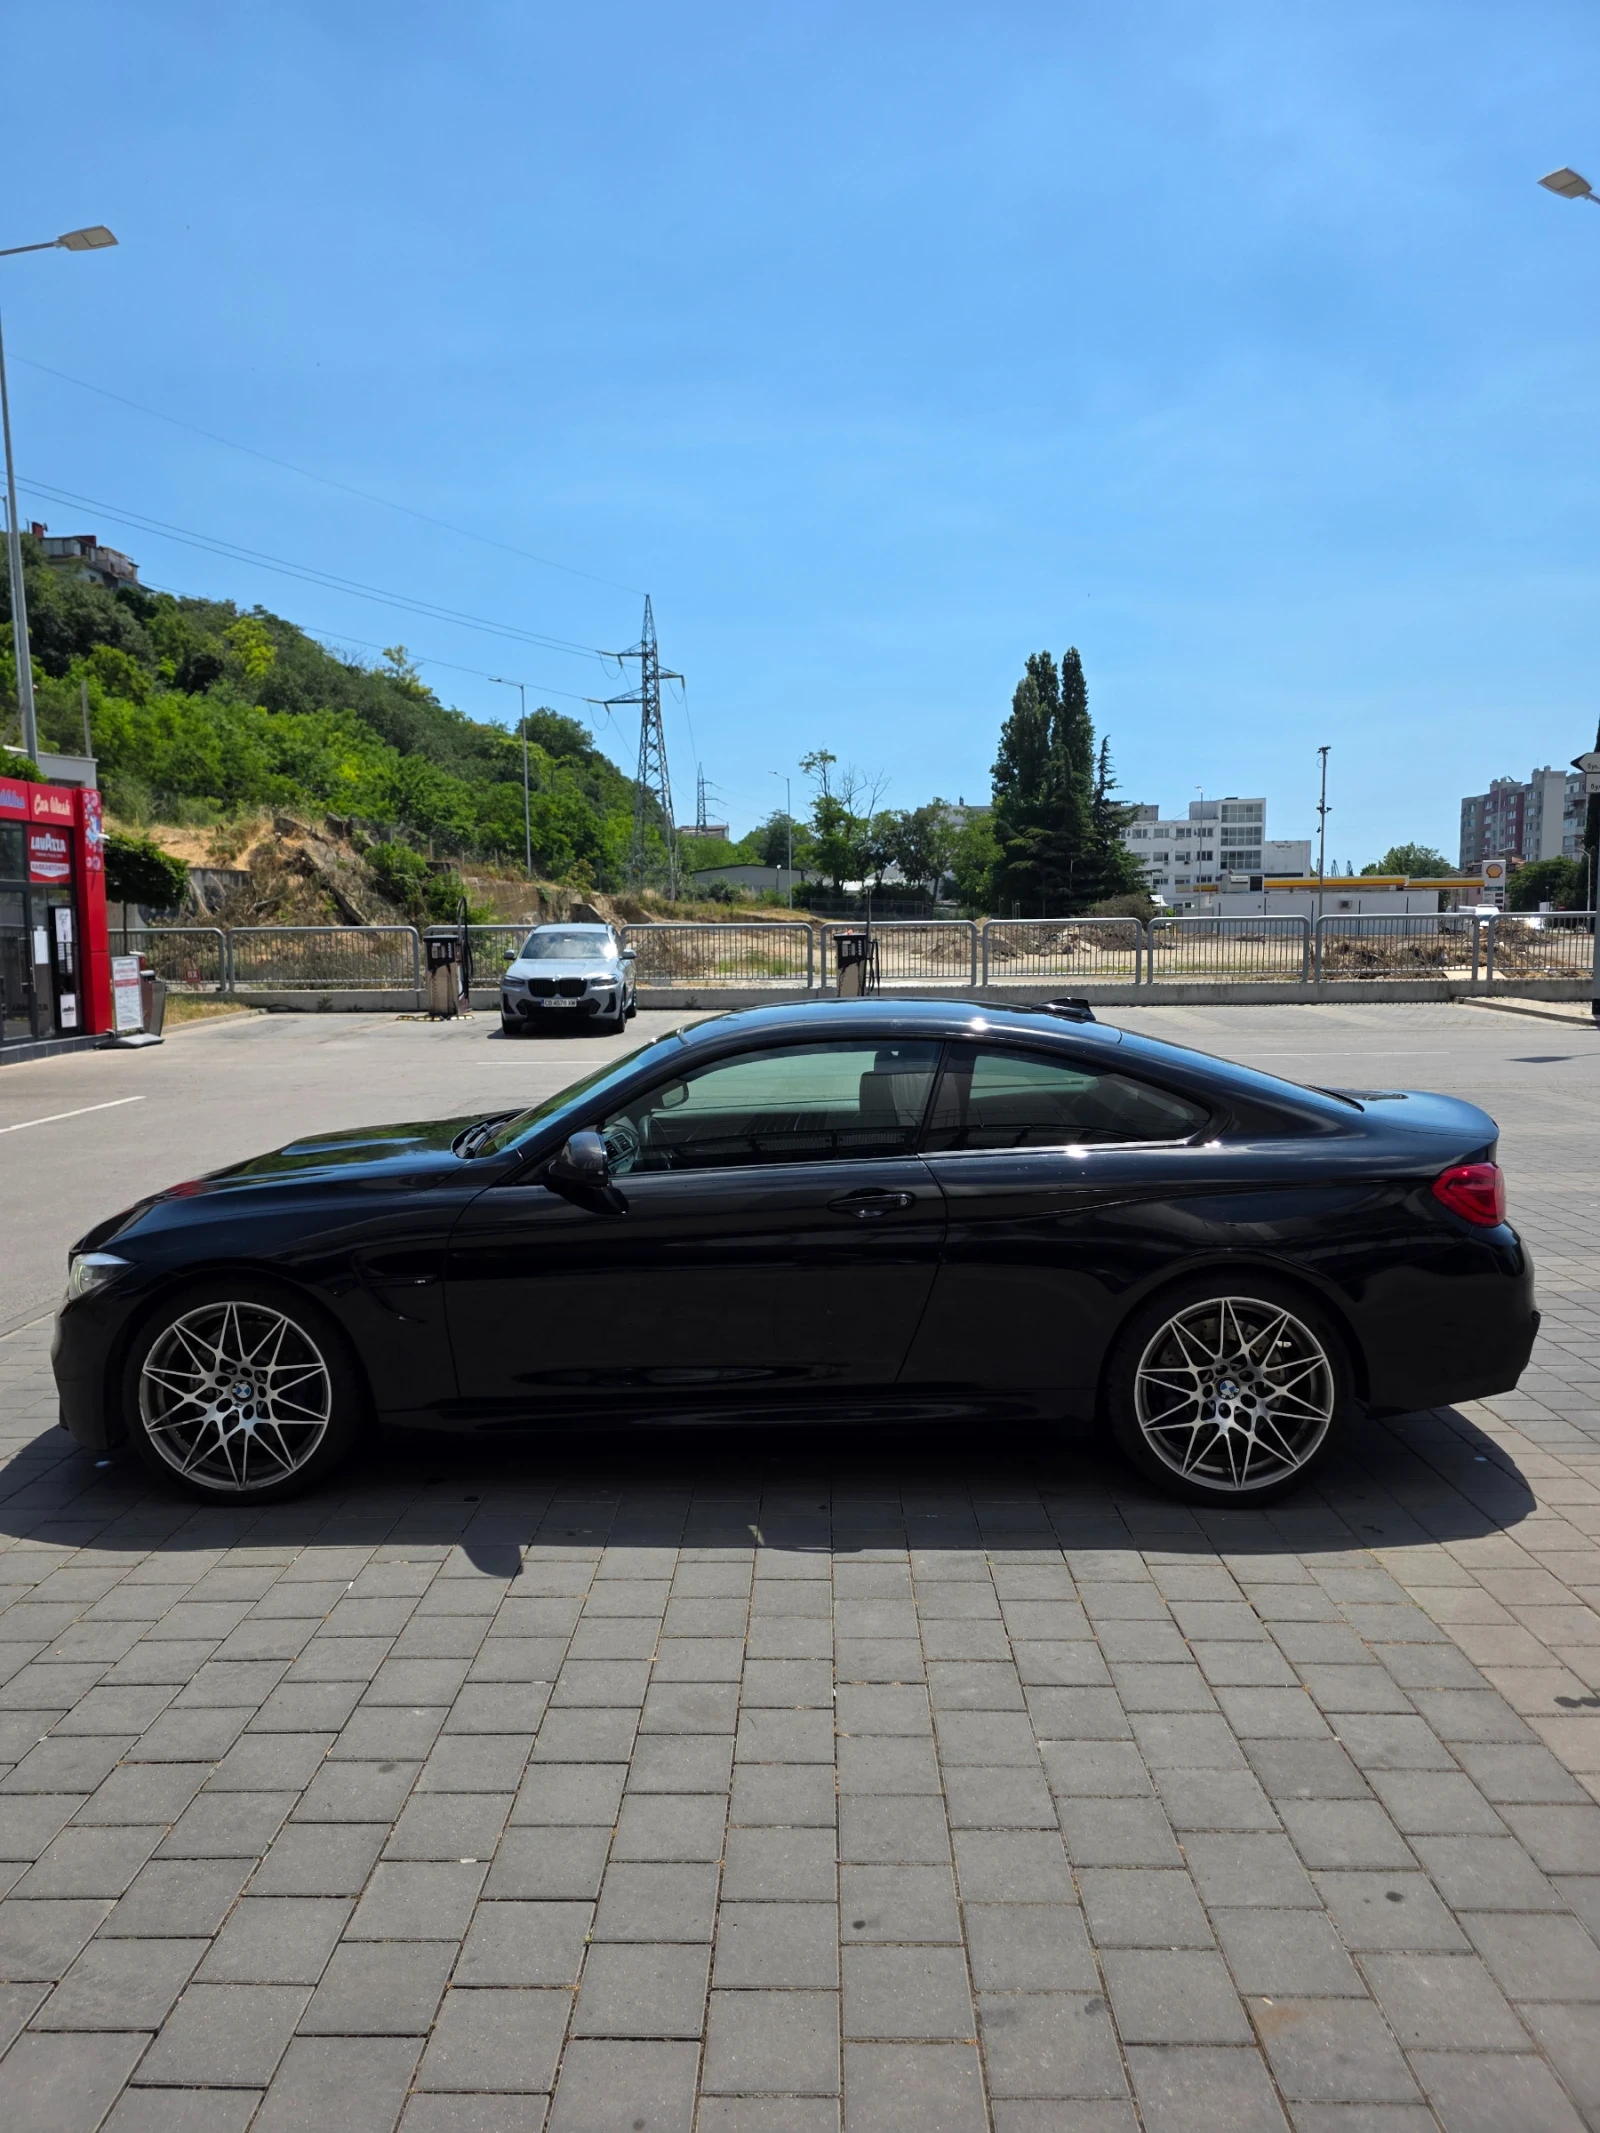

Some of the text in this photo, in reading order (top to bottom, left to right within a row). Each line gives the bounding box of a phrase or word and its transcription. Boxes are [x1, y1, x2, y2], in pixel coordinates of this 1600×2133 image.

[34, 794, 71, 816] Car Wash
[30, 832, 66, 853] LAVAZZA
